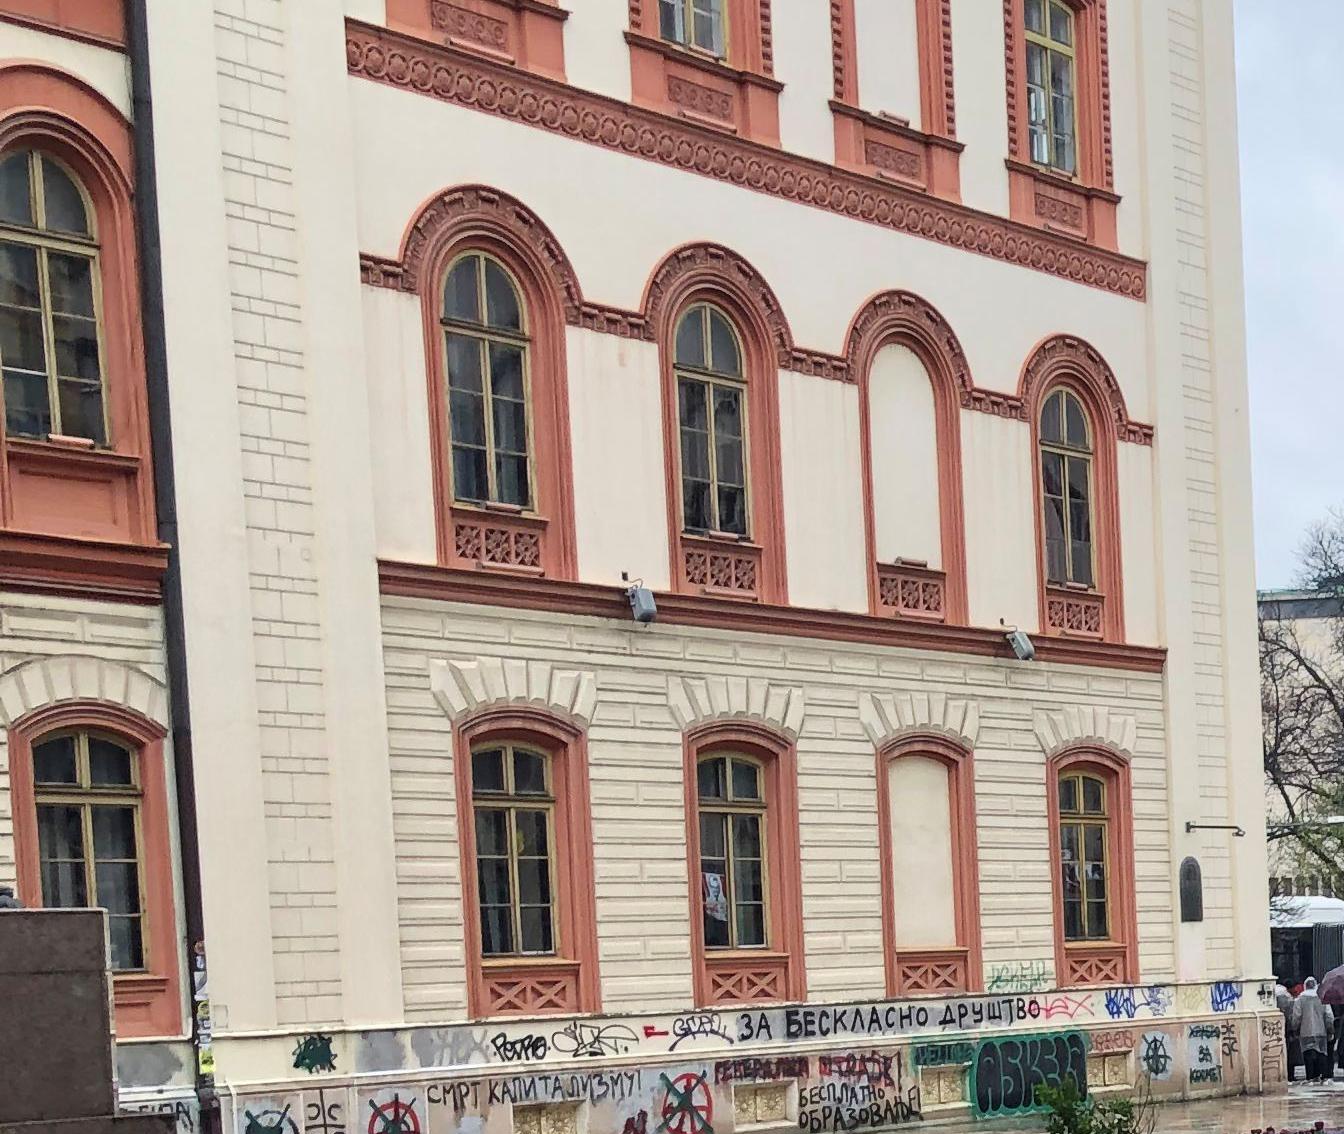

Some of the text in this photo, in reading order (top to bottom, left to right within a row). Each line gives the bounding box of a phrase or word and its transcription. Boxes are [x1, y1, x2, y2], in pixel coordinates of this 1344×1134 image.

[738, 1012, 773, 1041] ЗА
[785, 1006, 929, 1039] БЕСКЛАСНО
[938, 998, 1041, 1029] ДРУШТВО
[427, 1069, 642, 1112] СМРТ КАПИТАЛИЗМУ!
[800, 1083, 885, 1107] БЕСПЛАТНО
